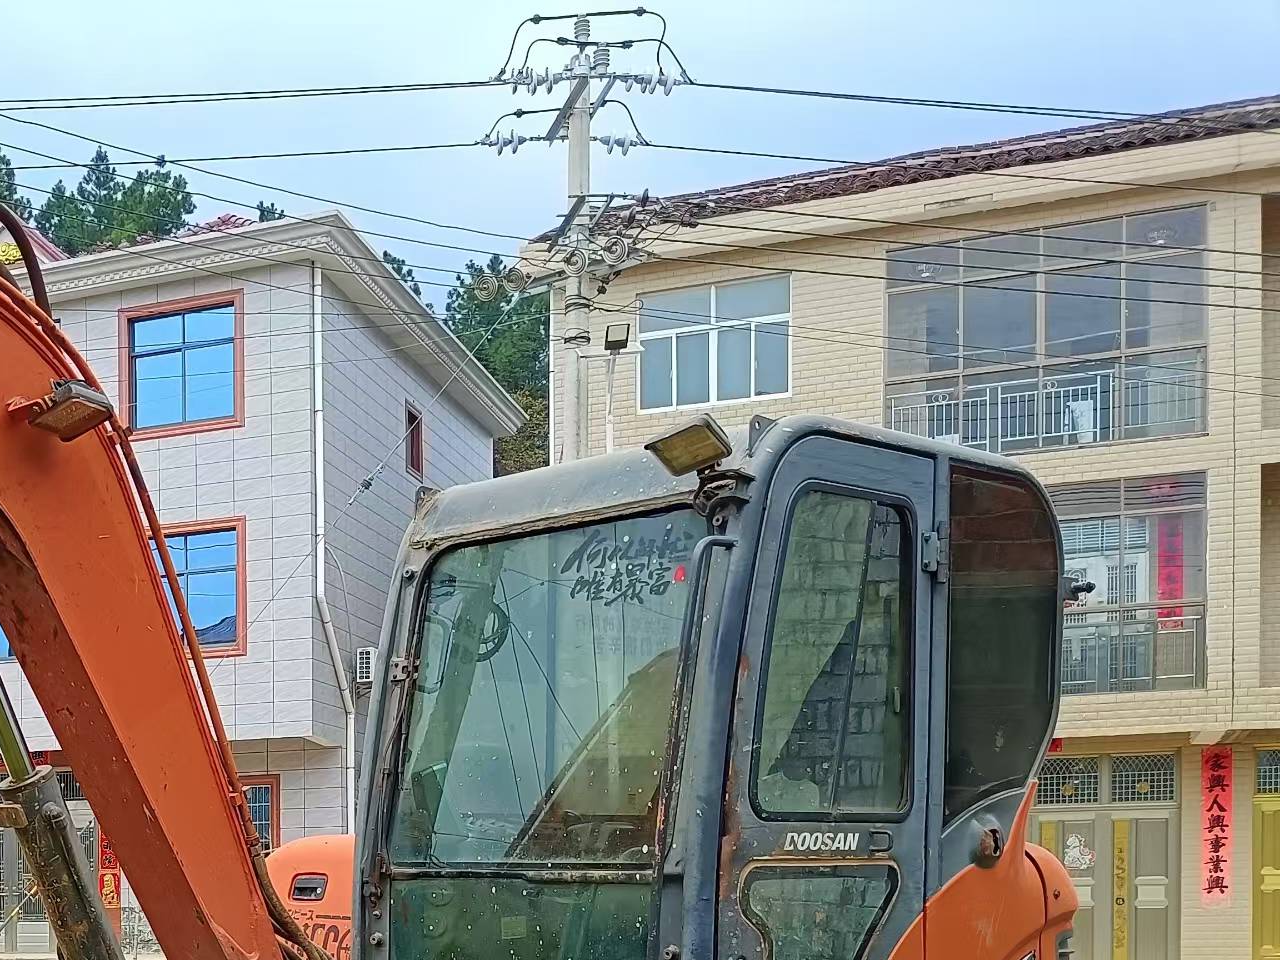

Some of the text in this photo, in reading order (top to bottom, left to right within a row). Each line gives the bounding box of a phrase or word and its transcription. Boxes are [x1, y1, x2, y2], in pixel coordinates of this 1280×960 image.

[783, 831, 860, 851] DOOSAN
[1202, 751, 1231, 895] 家興人興事業興
